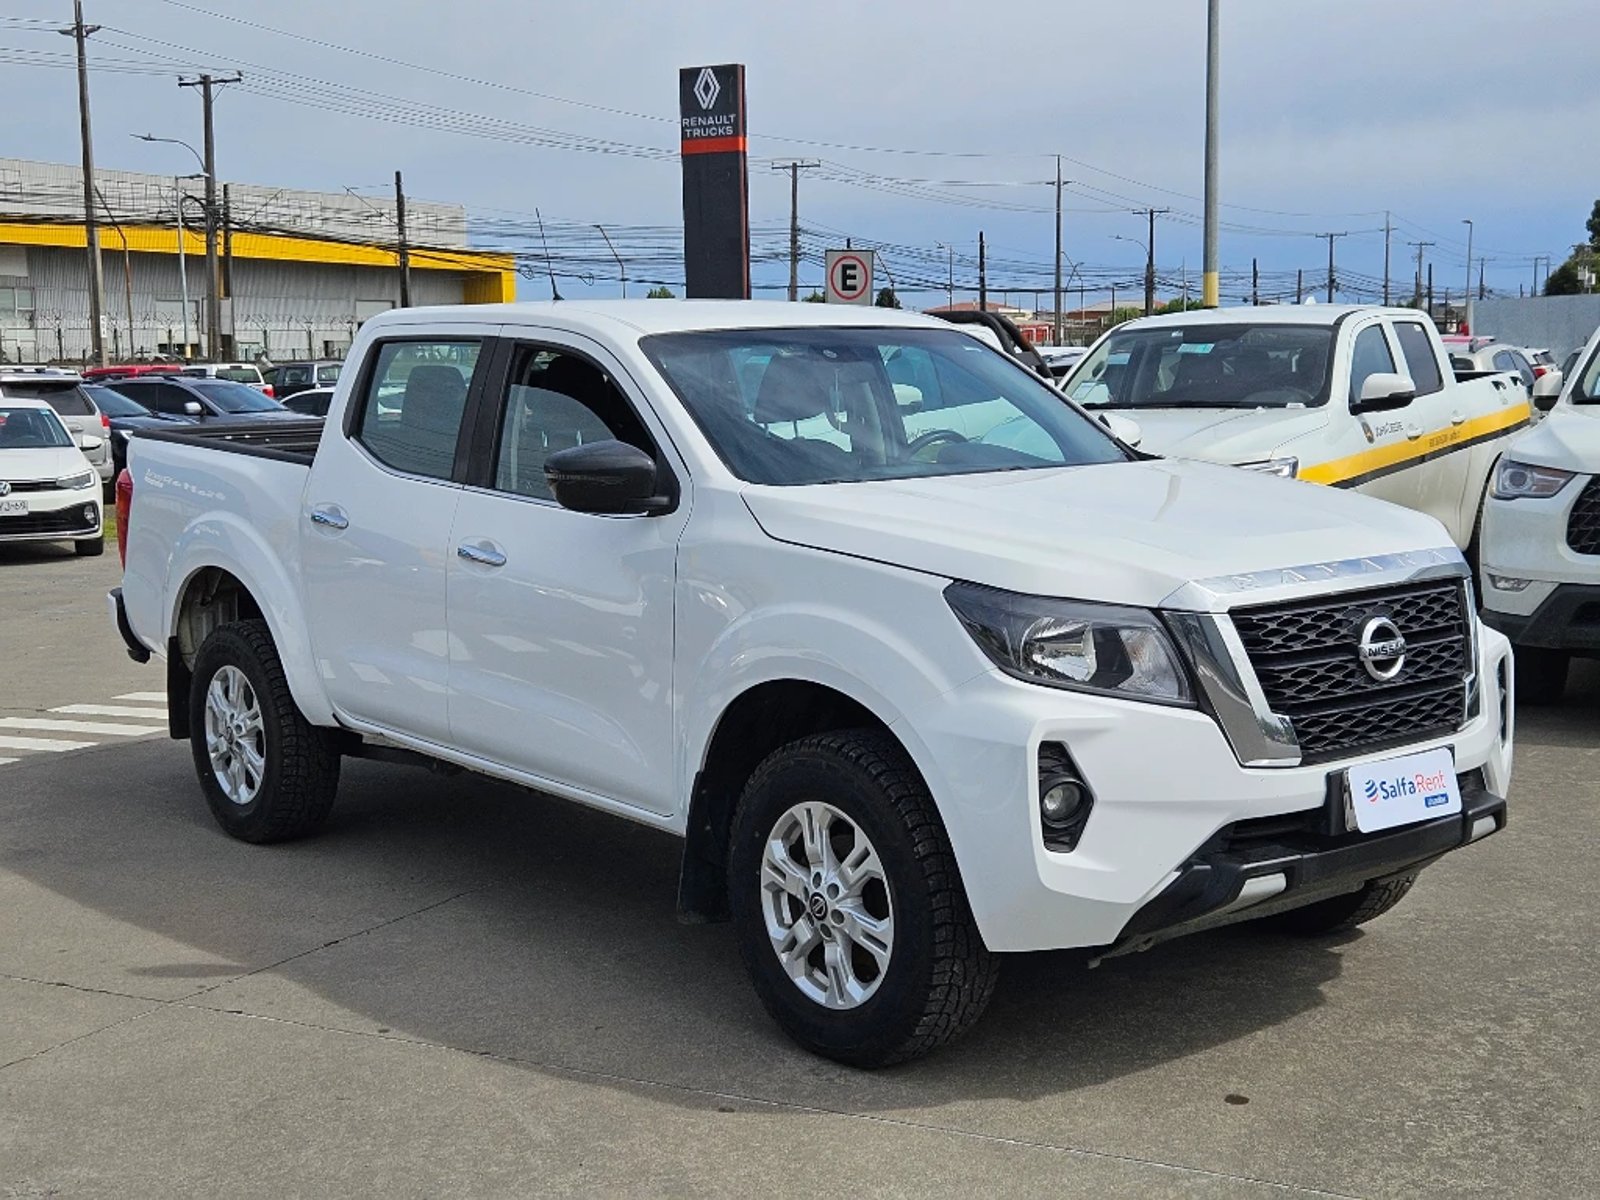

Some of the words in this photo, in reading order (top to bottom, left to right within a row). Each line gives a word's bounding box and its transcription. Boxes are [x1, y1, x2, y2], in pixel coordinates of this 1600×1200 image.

[682, 113, 736, 127] RENAULT
[684, 126, 734, 138] TRUCKS
[842, 263, 857, 291] E
[1231, 550, 1448, 590] NAVARA
[1368, 640, 1406, 657] NISSAN
[1379, 769, 1447, 800] SalfaRent
